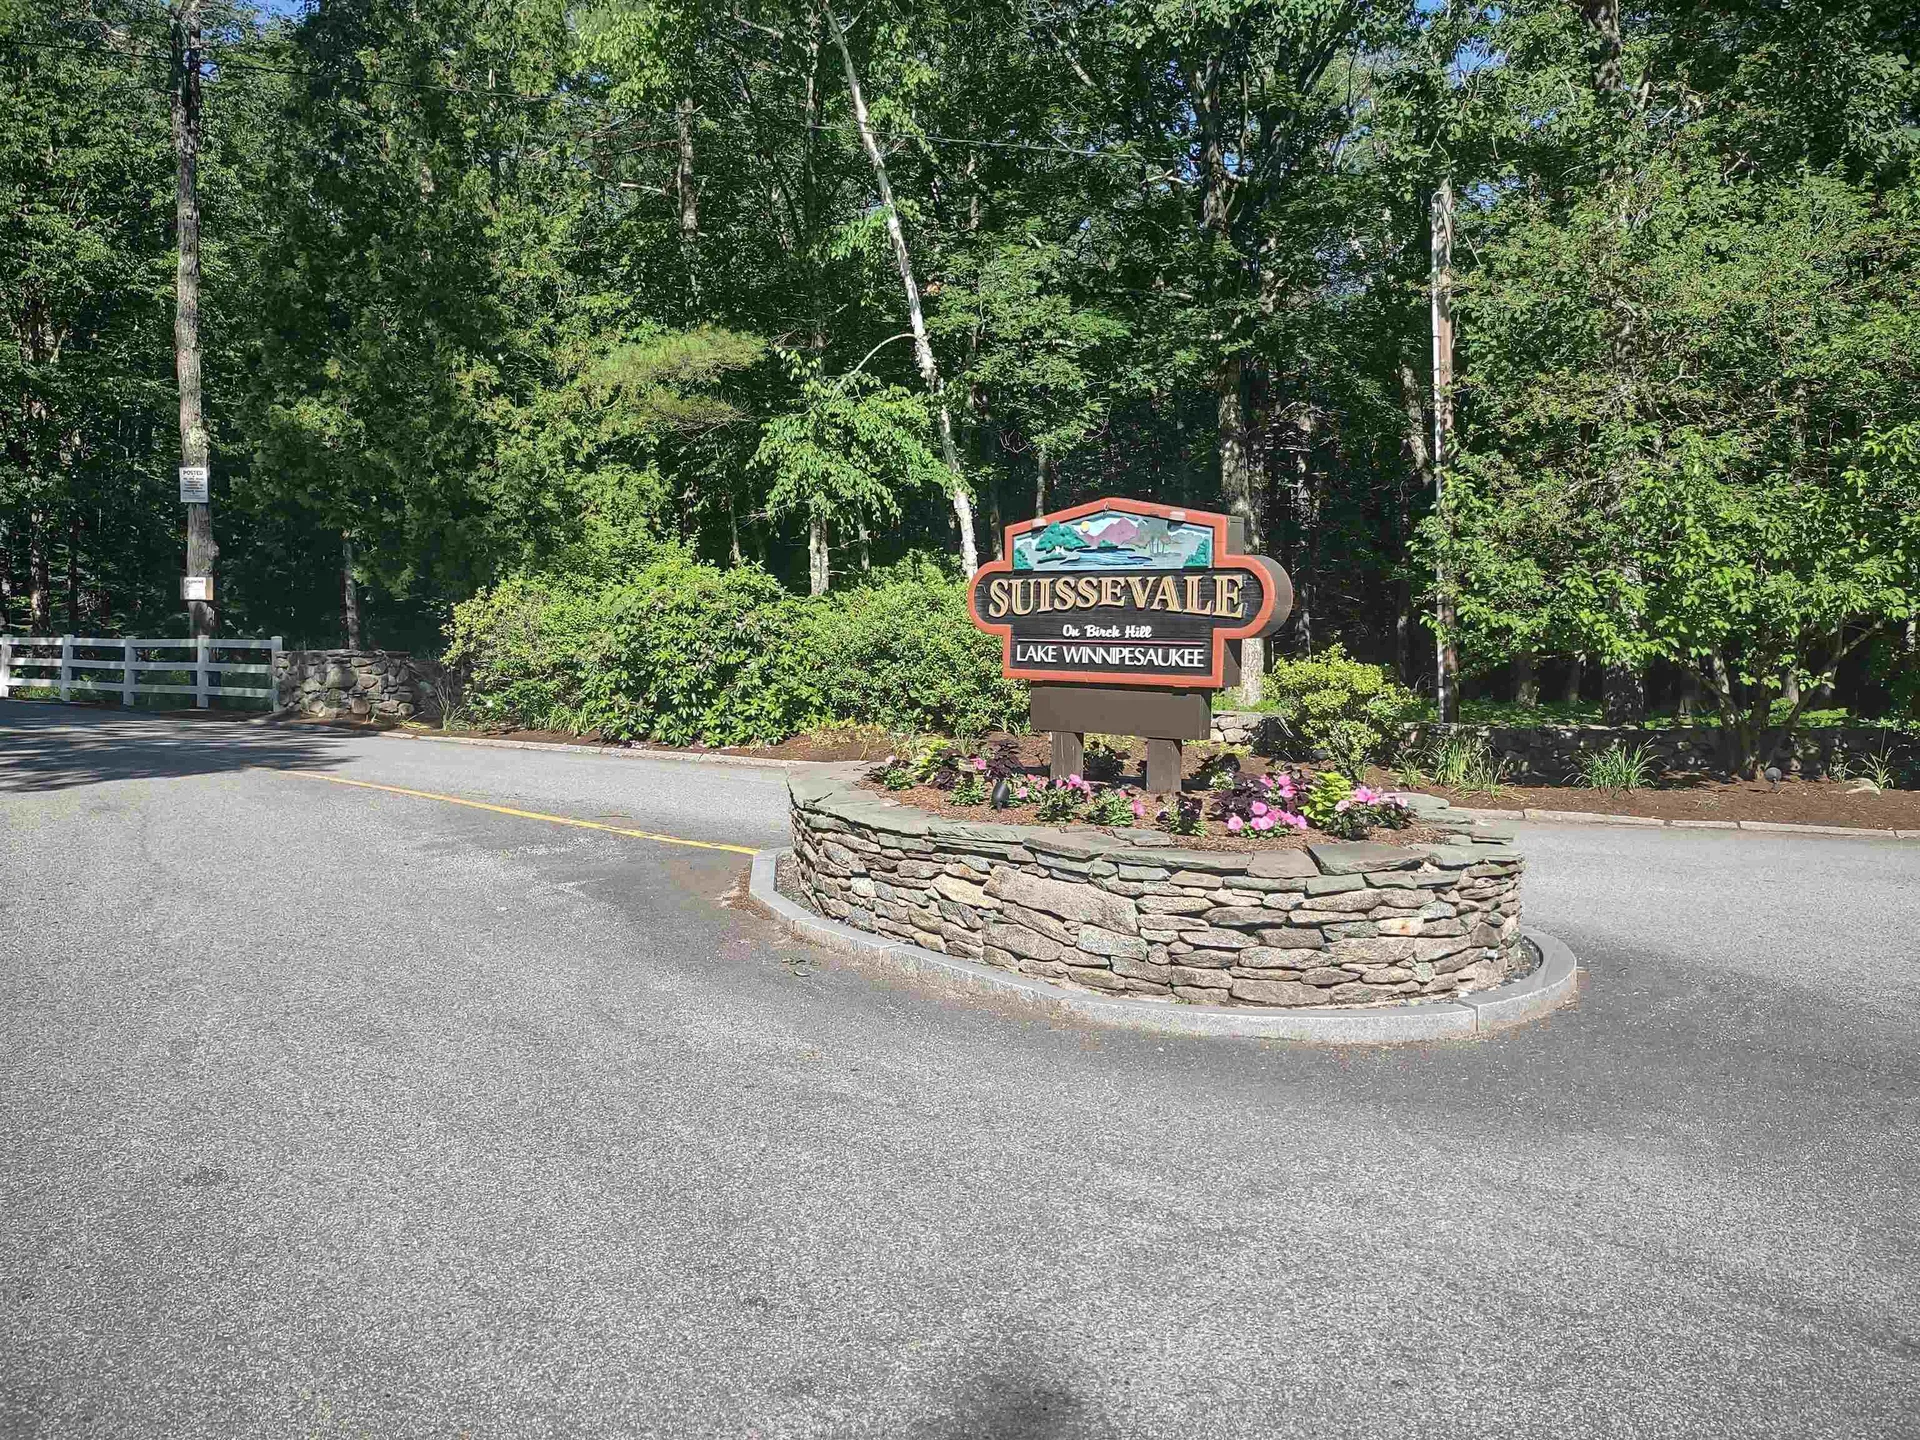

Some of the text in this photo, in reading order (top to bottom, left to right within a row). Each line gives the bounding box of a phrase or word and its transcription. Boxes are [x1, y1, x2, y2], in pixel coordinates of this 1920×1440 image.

[988, 574, 1245, 619] SUISSEVALE
[1062, 624, 1152, 638] On Birch Hill
[1016, 644, 1205, 668] LAKE WINNIPESAUKEE
